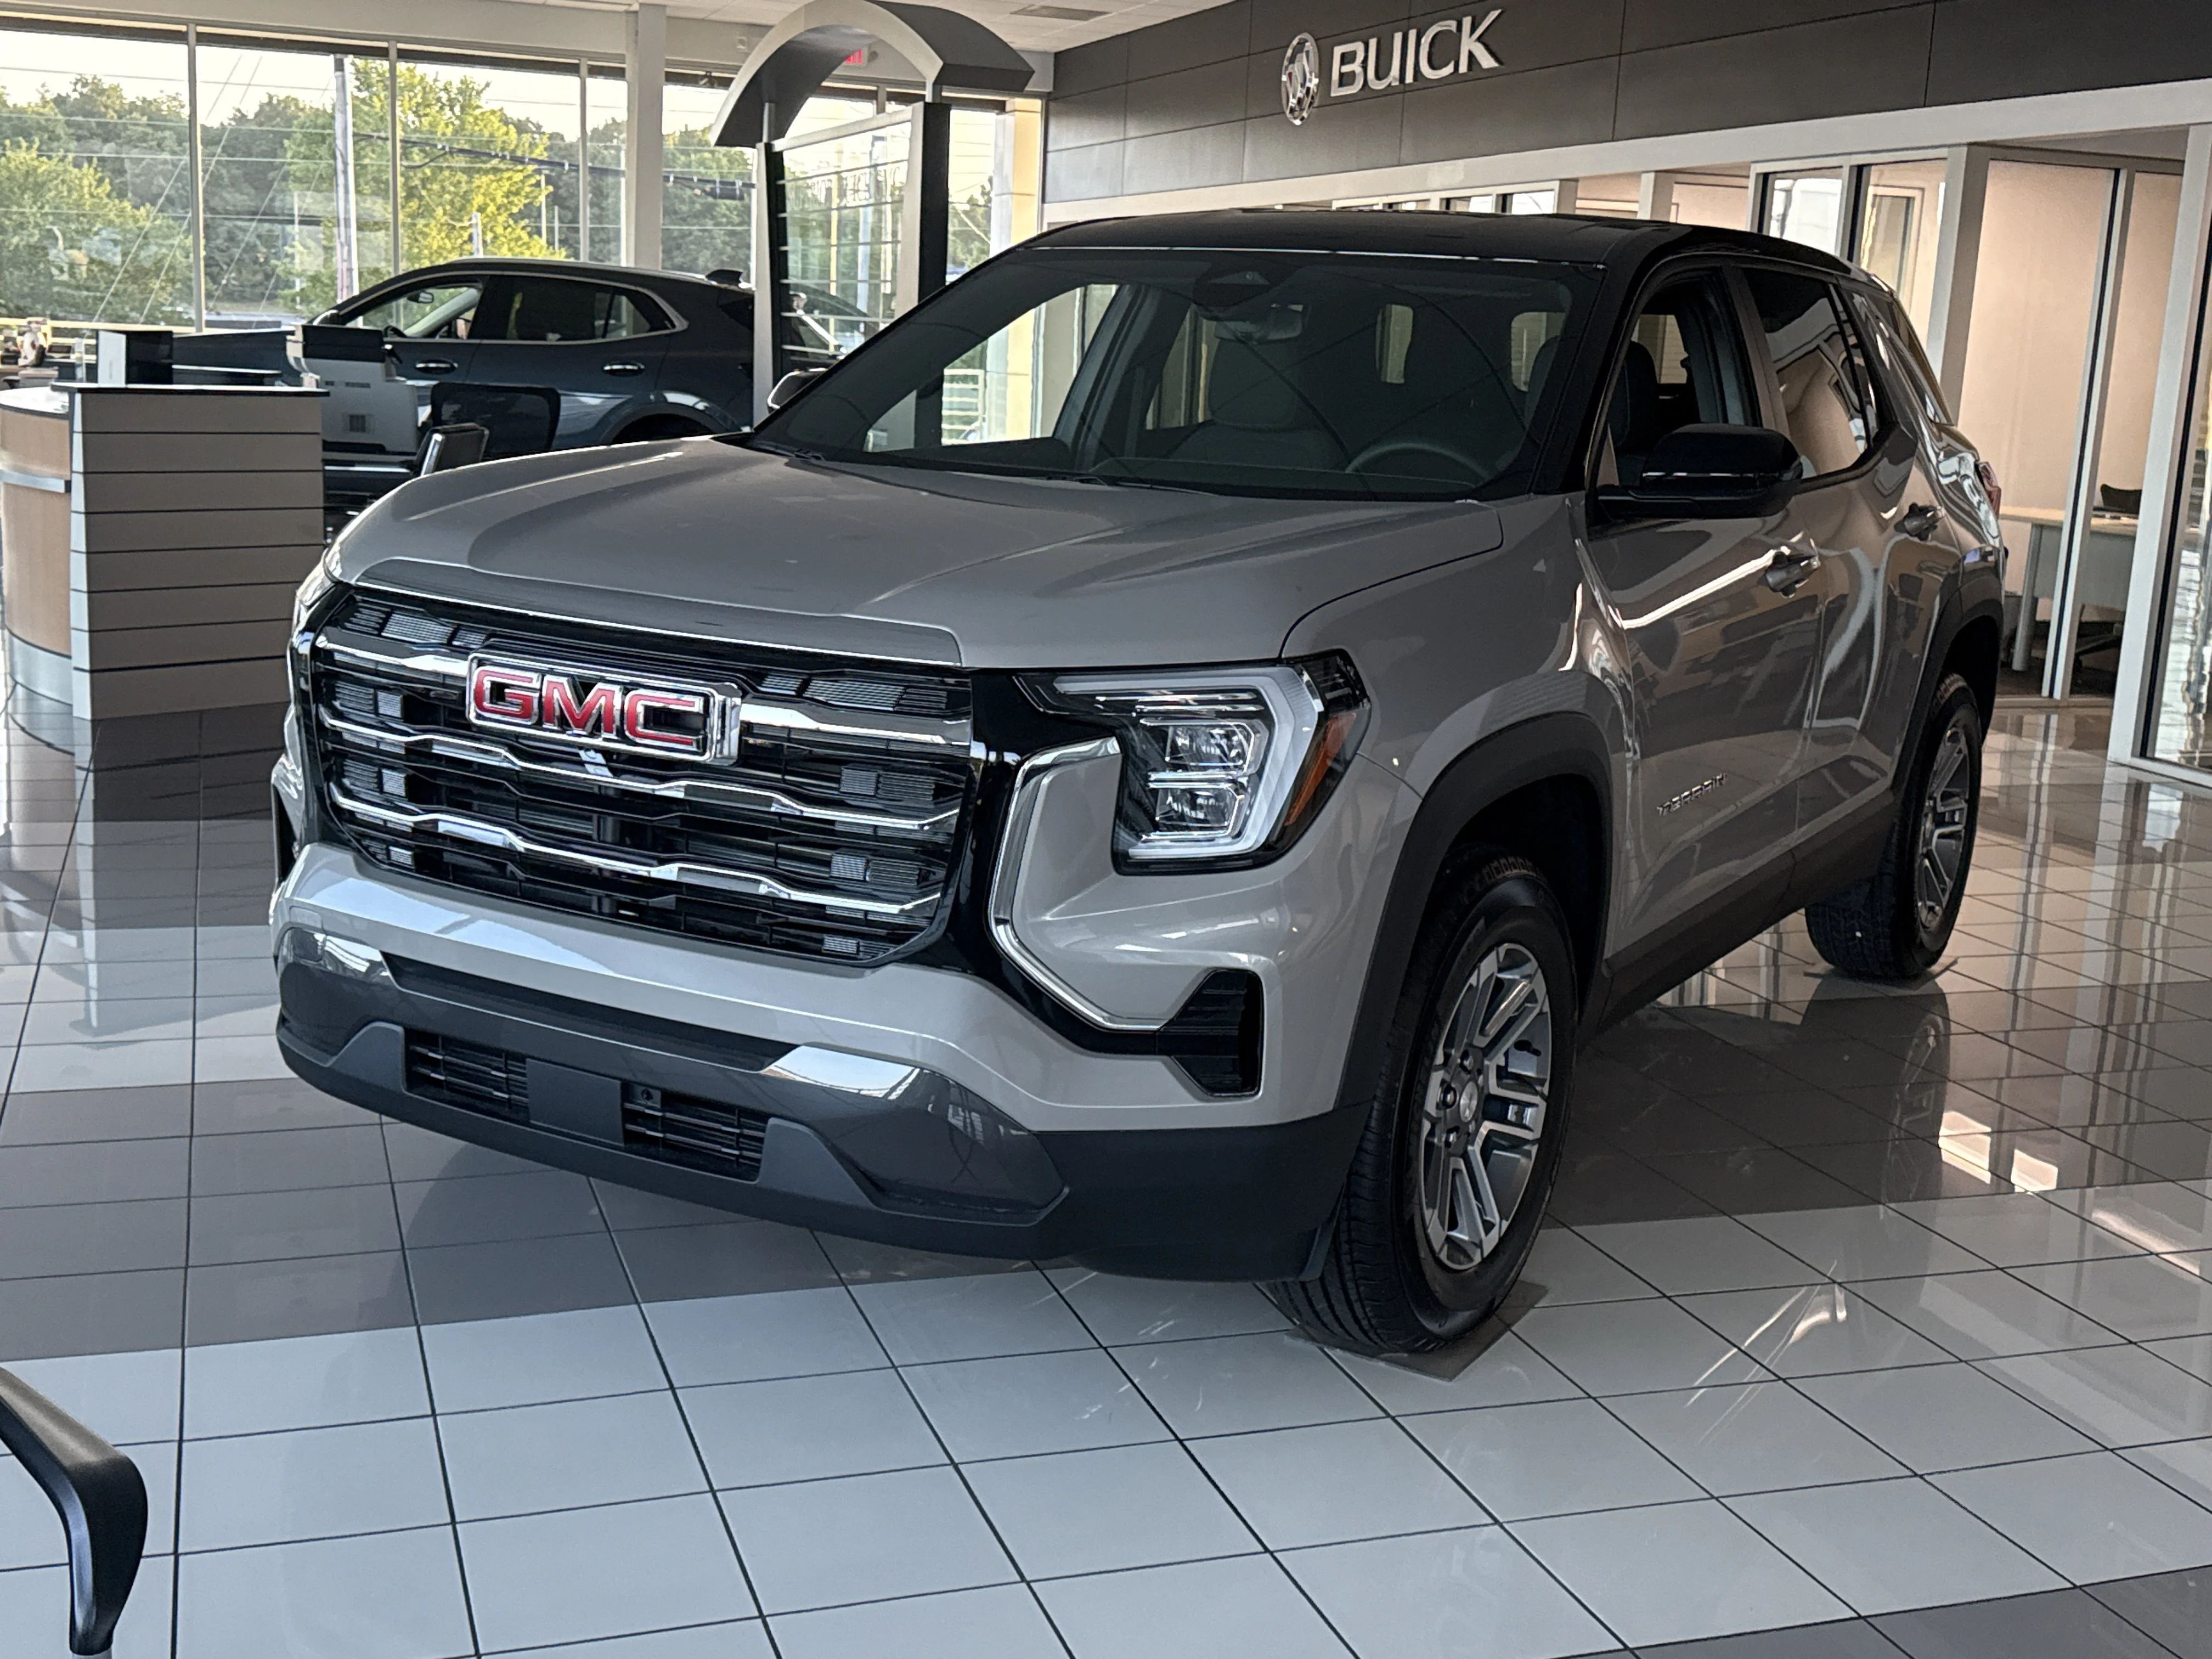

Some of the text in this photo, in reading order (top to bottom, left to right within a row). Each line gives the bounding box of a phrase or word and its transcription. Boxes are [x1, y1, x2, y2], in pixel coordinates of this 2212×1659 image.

[1330, 9, 1503, 97] BUICK
[473, 665, 704, 753] GMC
[1656, 772, 1728, 817] TERRAIN
